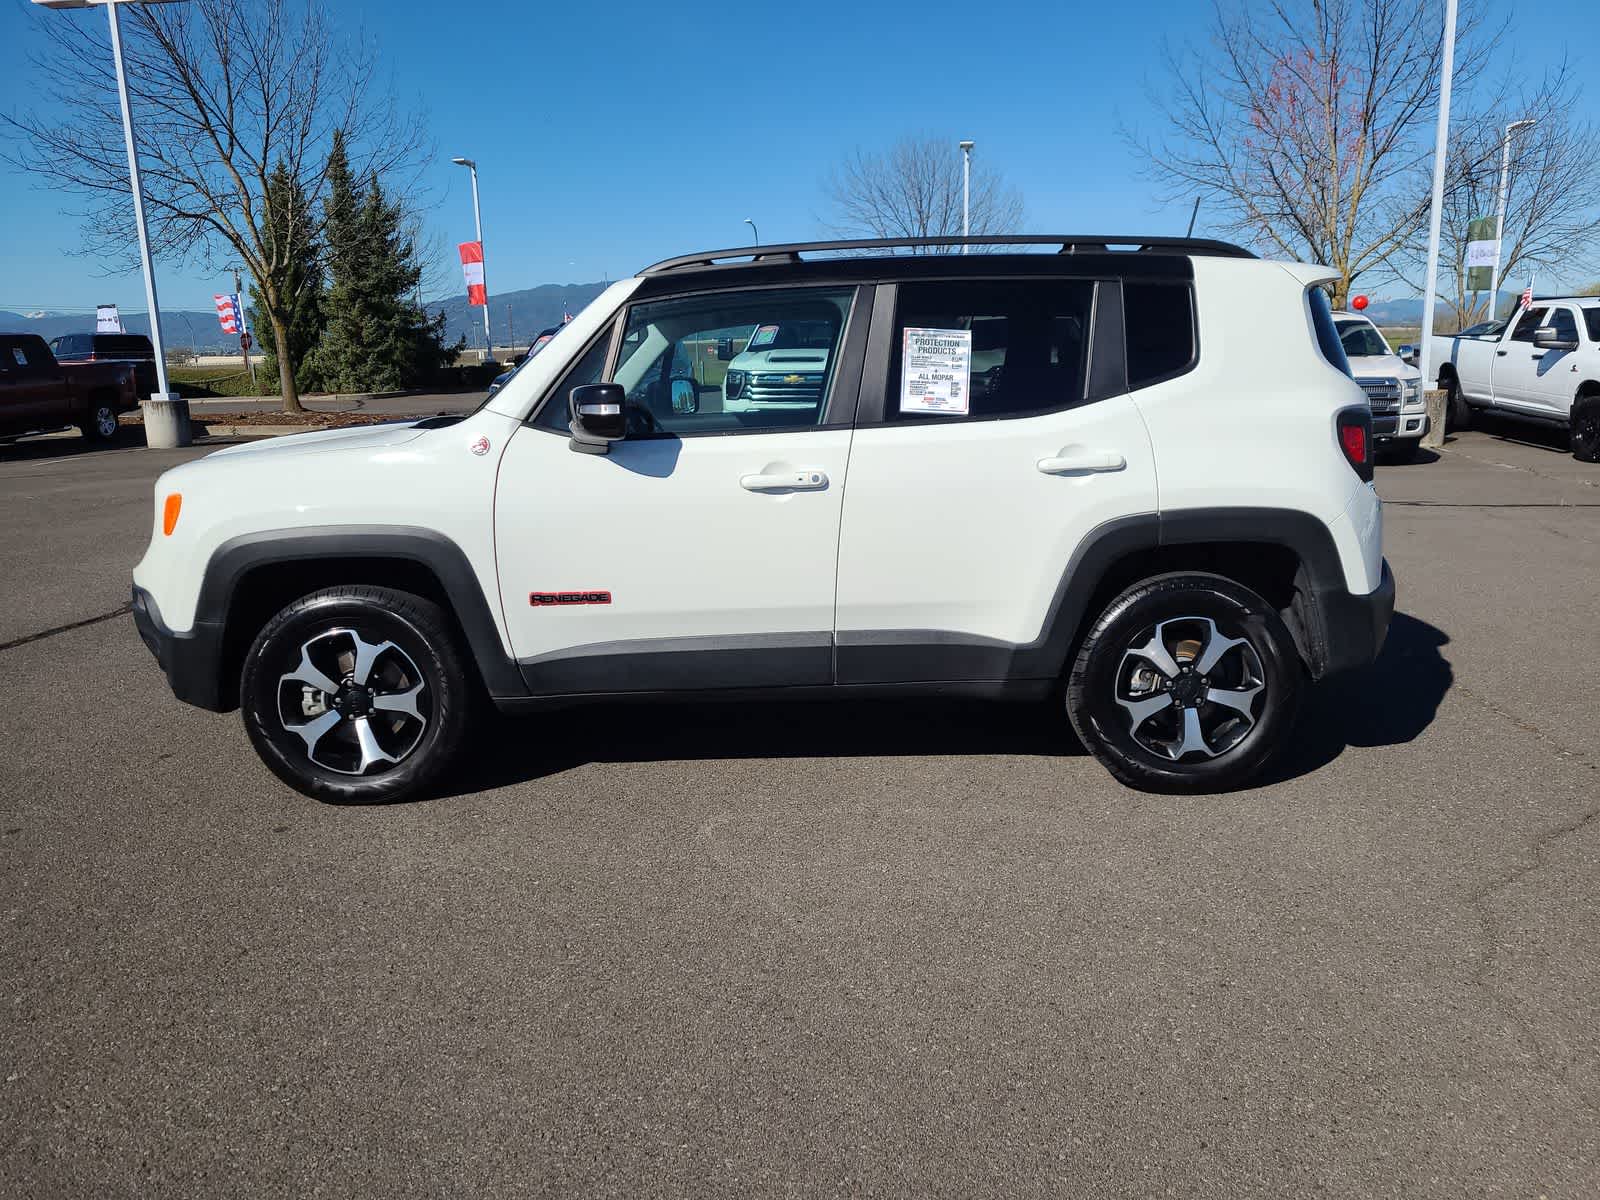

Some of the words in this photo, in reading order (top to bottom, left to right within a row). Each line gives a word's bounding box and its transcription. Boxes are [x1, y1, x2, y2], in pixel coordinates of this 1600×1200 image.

[915, 338, 960, 347] PROTECTION
[918, 347, 957, 355] PRODUCTS
[931, 373, 954, 381] MOPAR
[530, 592, 611, 605] RENEGADE
